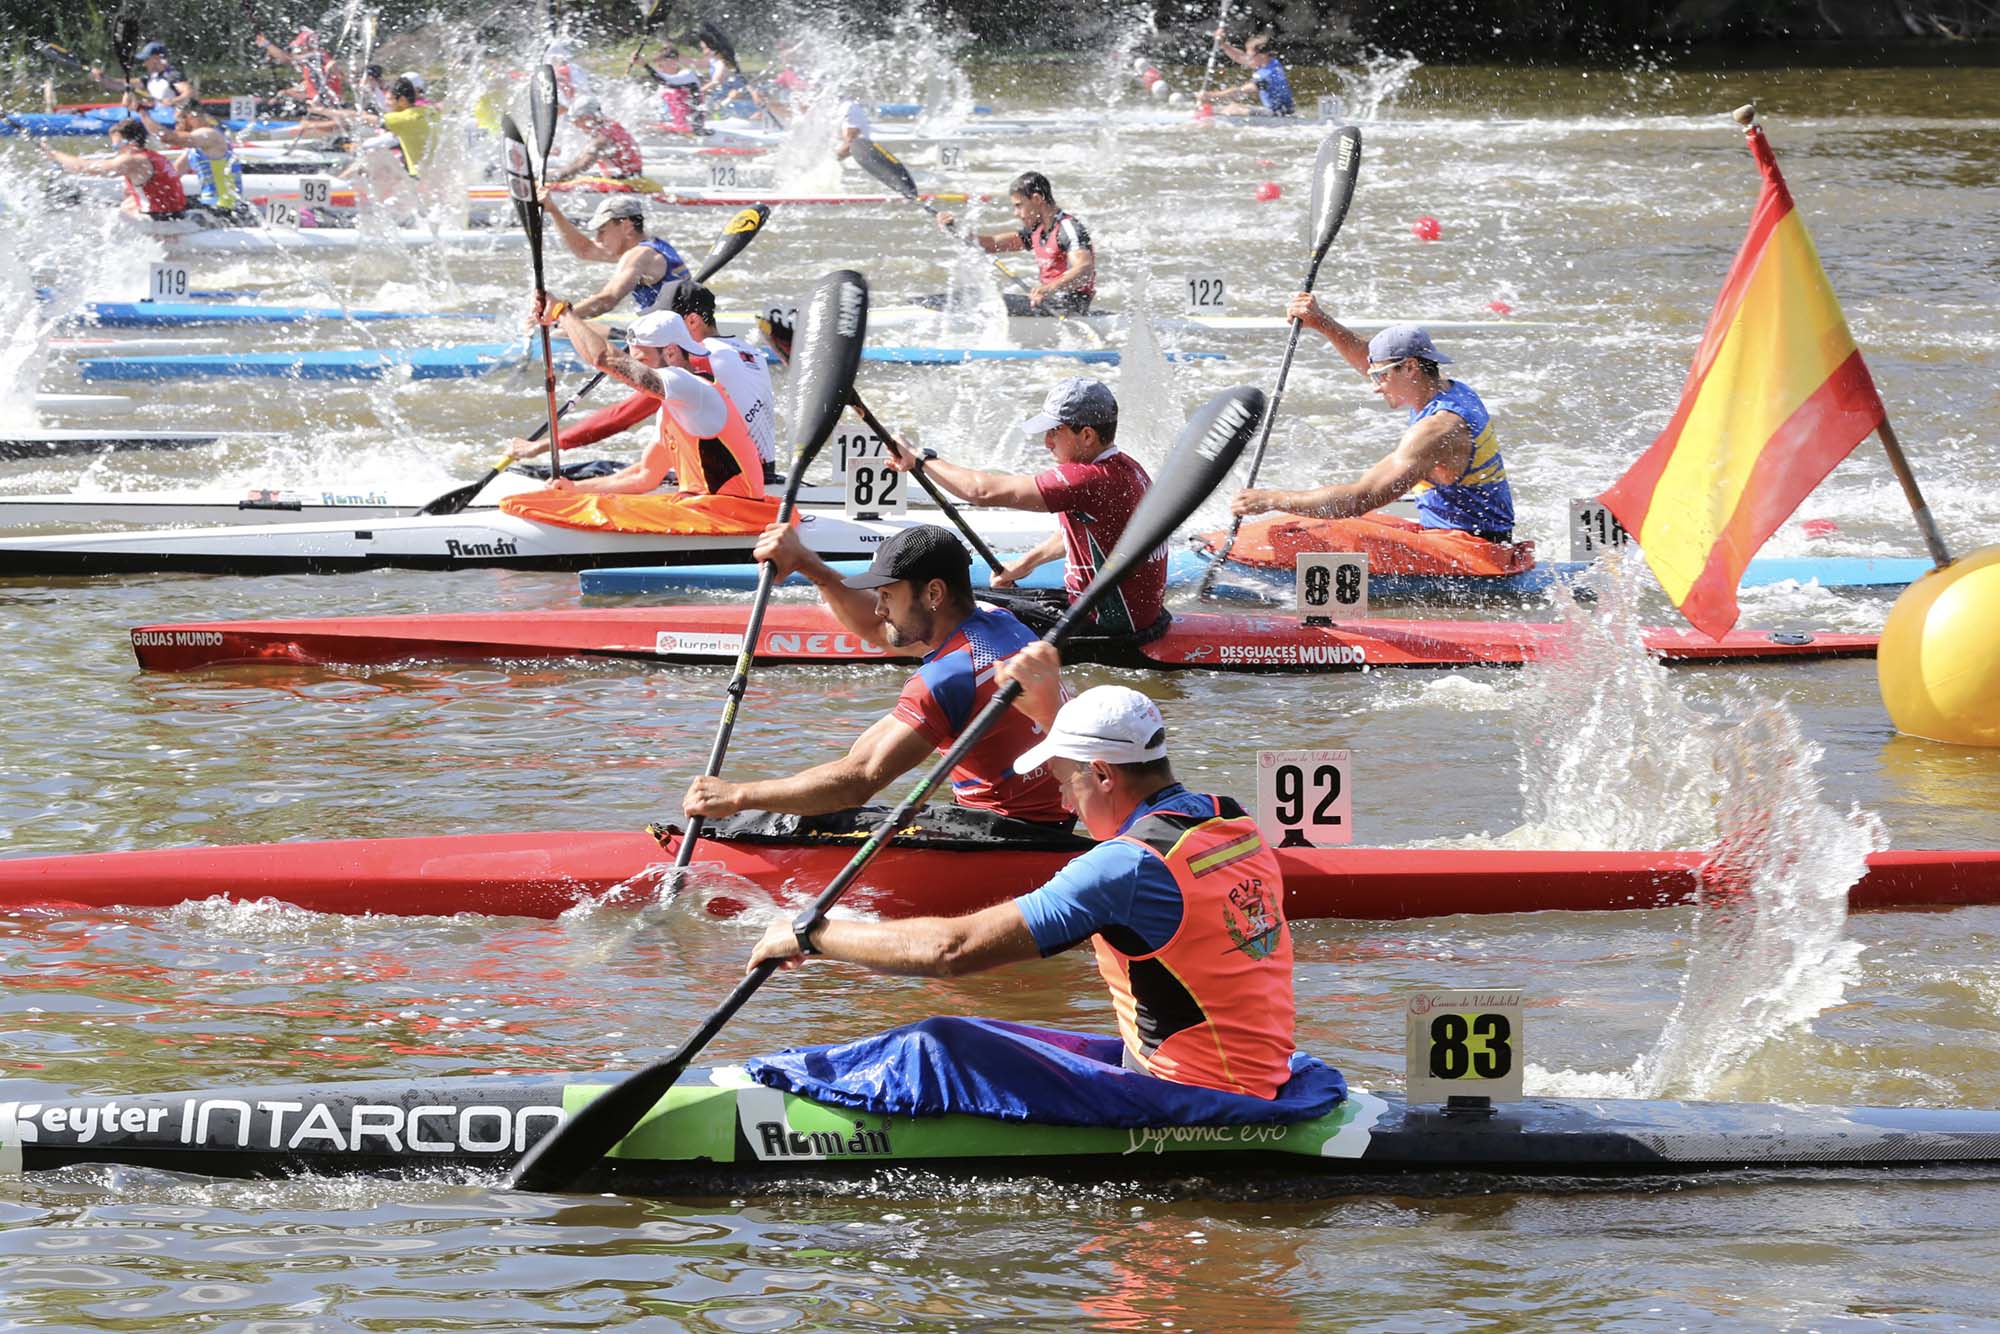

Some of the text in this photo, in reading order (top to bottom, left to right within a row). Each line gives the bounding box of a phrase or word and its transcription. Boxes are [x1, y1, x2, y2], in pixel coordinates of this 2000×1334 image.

[711, 167, 736, 186] 123
[304, 182, 327, 202] 93
[157, 269, 186, 296] 119
[1189, 279, 1224, 306] 122
[854, 466, 899, 506] 82
[1305, 563, 1361, 606] 88
[133, 632, 223, 646] GRUAS MUNDO
[1220, 644, 1366, 665] DESGUACES MUNDO
[1275, 764, 1341, 826] 92
[1430, 1013, 1512, 1080] 83
[1240, 1124, 1287, 1143] evo
